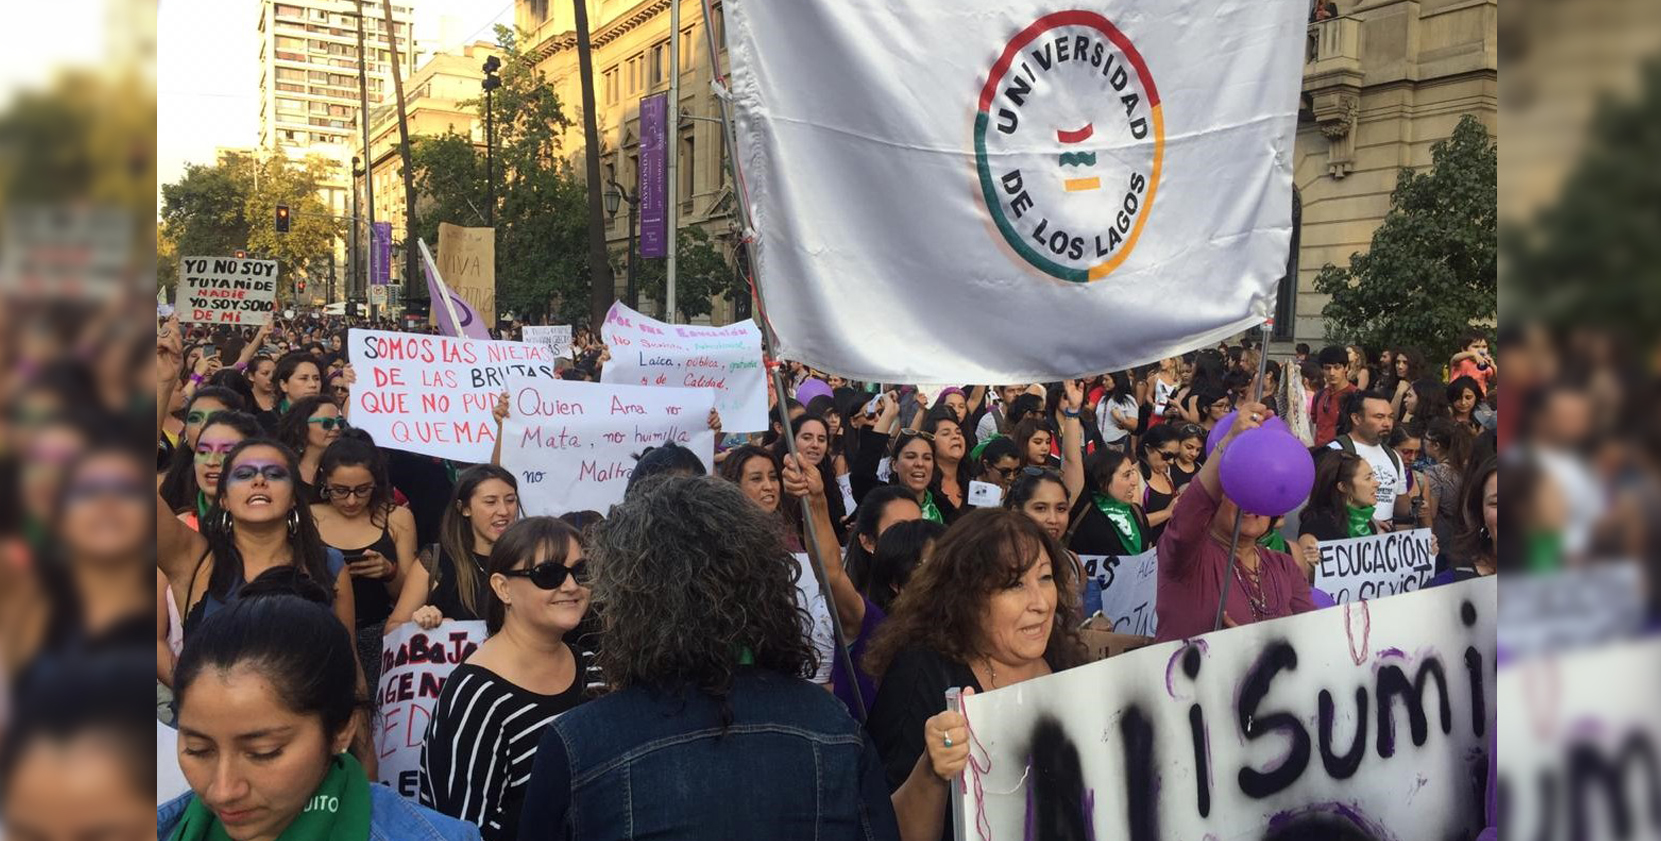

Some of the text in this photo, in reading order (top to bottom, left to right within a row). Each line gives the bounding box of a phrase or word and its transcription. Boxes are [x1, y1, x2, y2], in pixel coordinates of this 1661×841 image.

[997, 35, 1149, 141] UNIVERSIDAD
[1001, 169, 1145, 261] DE LOS LAGOS
[185, 260, 275, 277] YO NO SOY
[443, 254, 480, 277] VIVA
[187, 278, 230, 288] TUYA
[254, 281, 274, 291] DE
[190, 298, 207, 308] YO
[211, 299, 240, 310] SOY
[193, 310, 213, 321] DE
[364, 336, 552, 364] SOMOS LAS NIETAS
[374, 367, 405, 387] DE
[423, 370, 458, 388] LAS
[656, 372, 667, 385] de
[361, 392, 409, 414] QUE
[423, 394, 450, 413] NO
[517, 387, 584, 417] Quien
[391, 421, 495, 443] QUEMA
[603, 432, 626, 444] no
[523, 470, 546, 483] no
